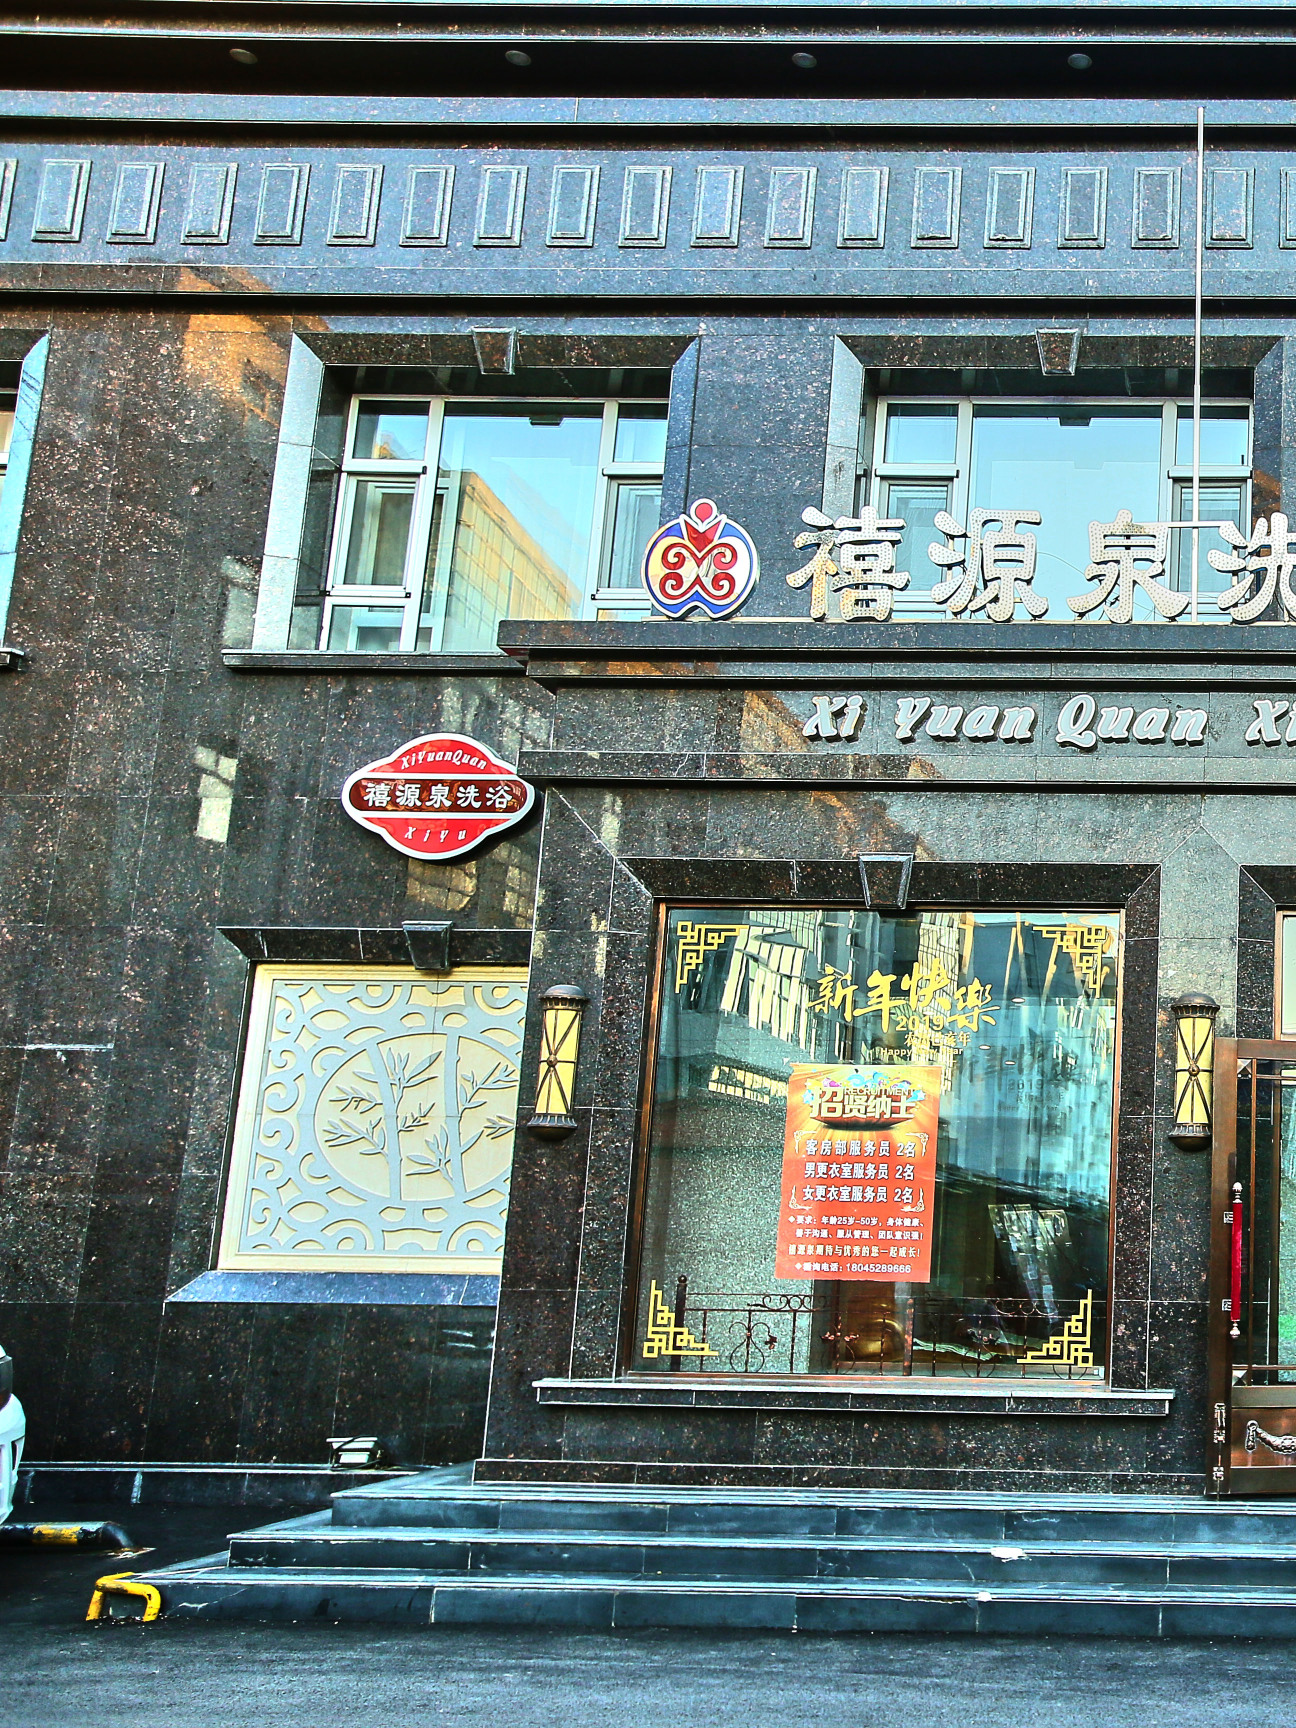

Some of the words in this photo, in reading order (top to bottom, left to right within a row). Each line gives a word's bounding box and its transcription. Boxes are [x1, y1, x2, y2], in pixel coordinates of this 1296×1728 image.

[802, 695, 867, 742] Xi
[895, 696, 1039, 743] Yuan
[1056, 694, 1208, 750] Quan
[363, 782, 513, 809] 禧源泉洗浴
[895, 1015, 945, 1031] 2019
[880, 1047, 912, 1057] Happy
[810, 1086, 916, 1118] 招贤纳士
[805, 1139, 891, 1157] 客房部服务员
[896, 1141, 916, 1158] 2名
[804, 1162, 889, 1179] 男更衣室服务员
[895, 1164, 915, 1180] 2名
[802, 1185, 888, 1202] 女更衣室服务员
[893, 1186, 914, 1203] 2名
